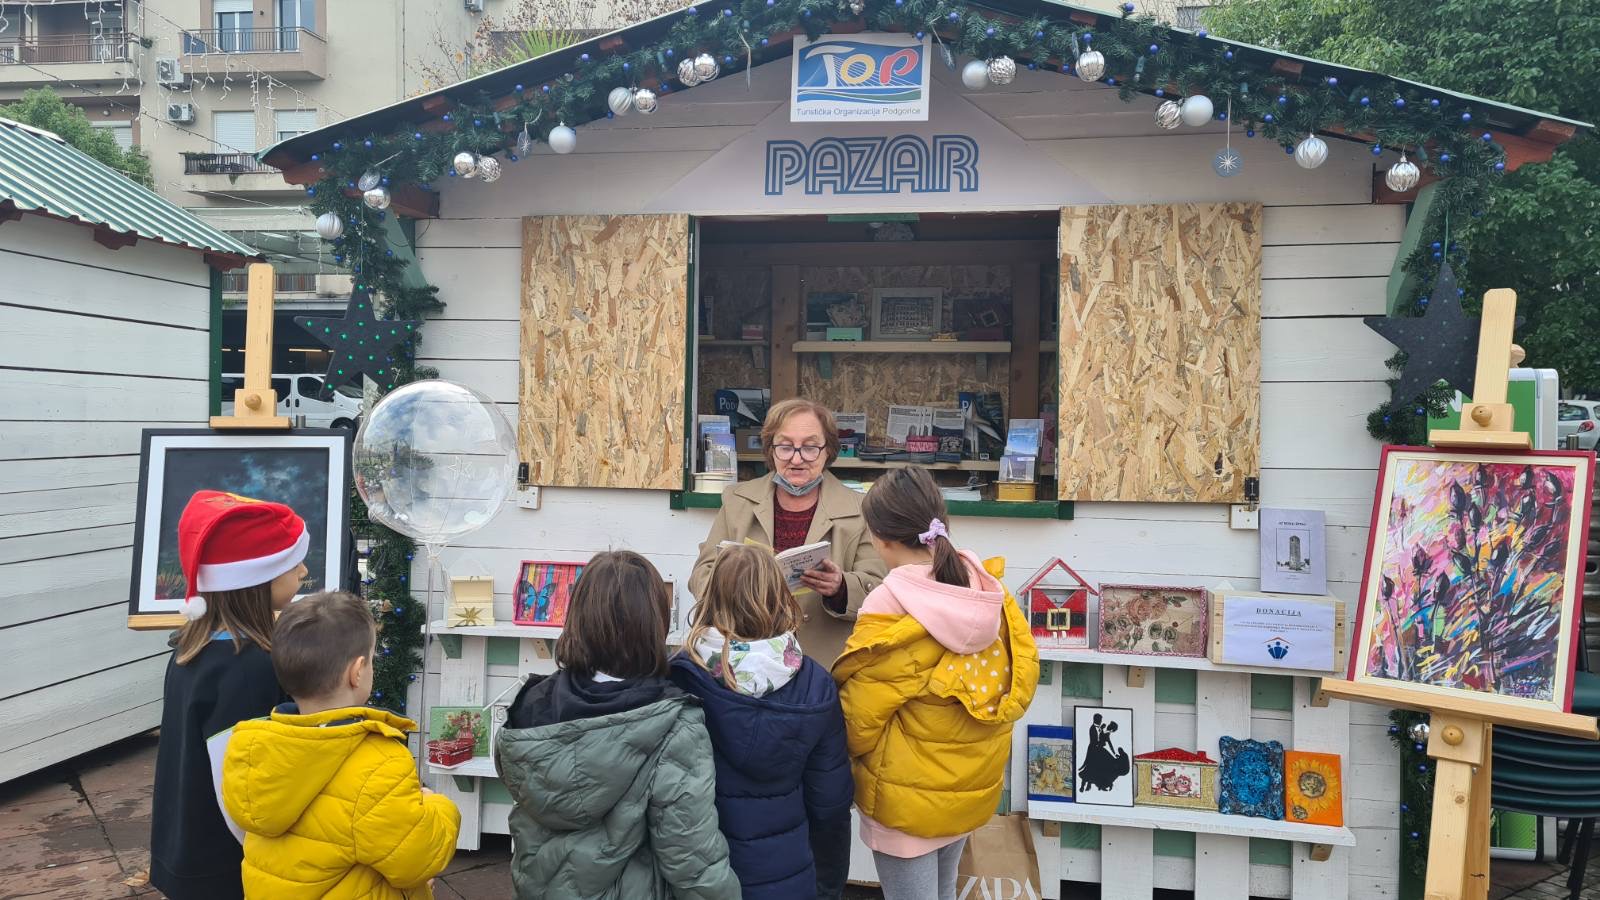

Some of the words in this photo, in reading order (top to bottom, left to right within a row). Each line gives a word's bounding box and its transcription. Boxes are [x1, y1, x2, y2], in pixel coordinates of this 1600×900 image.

[834, 107, 880, 117] Organizacija
[765, 134, 979, 195] PAZAR
[1256, 607, 1302, 617] DONACIJA
